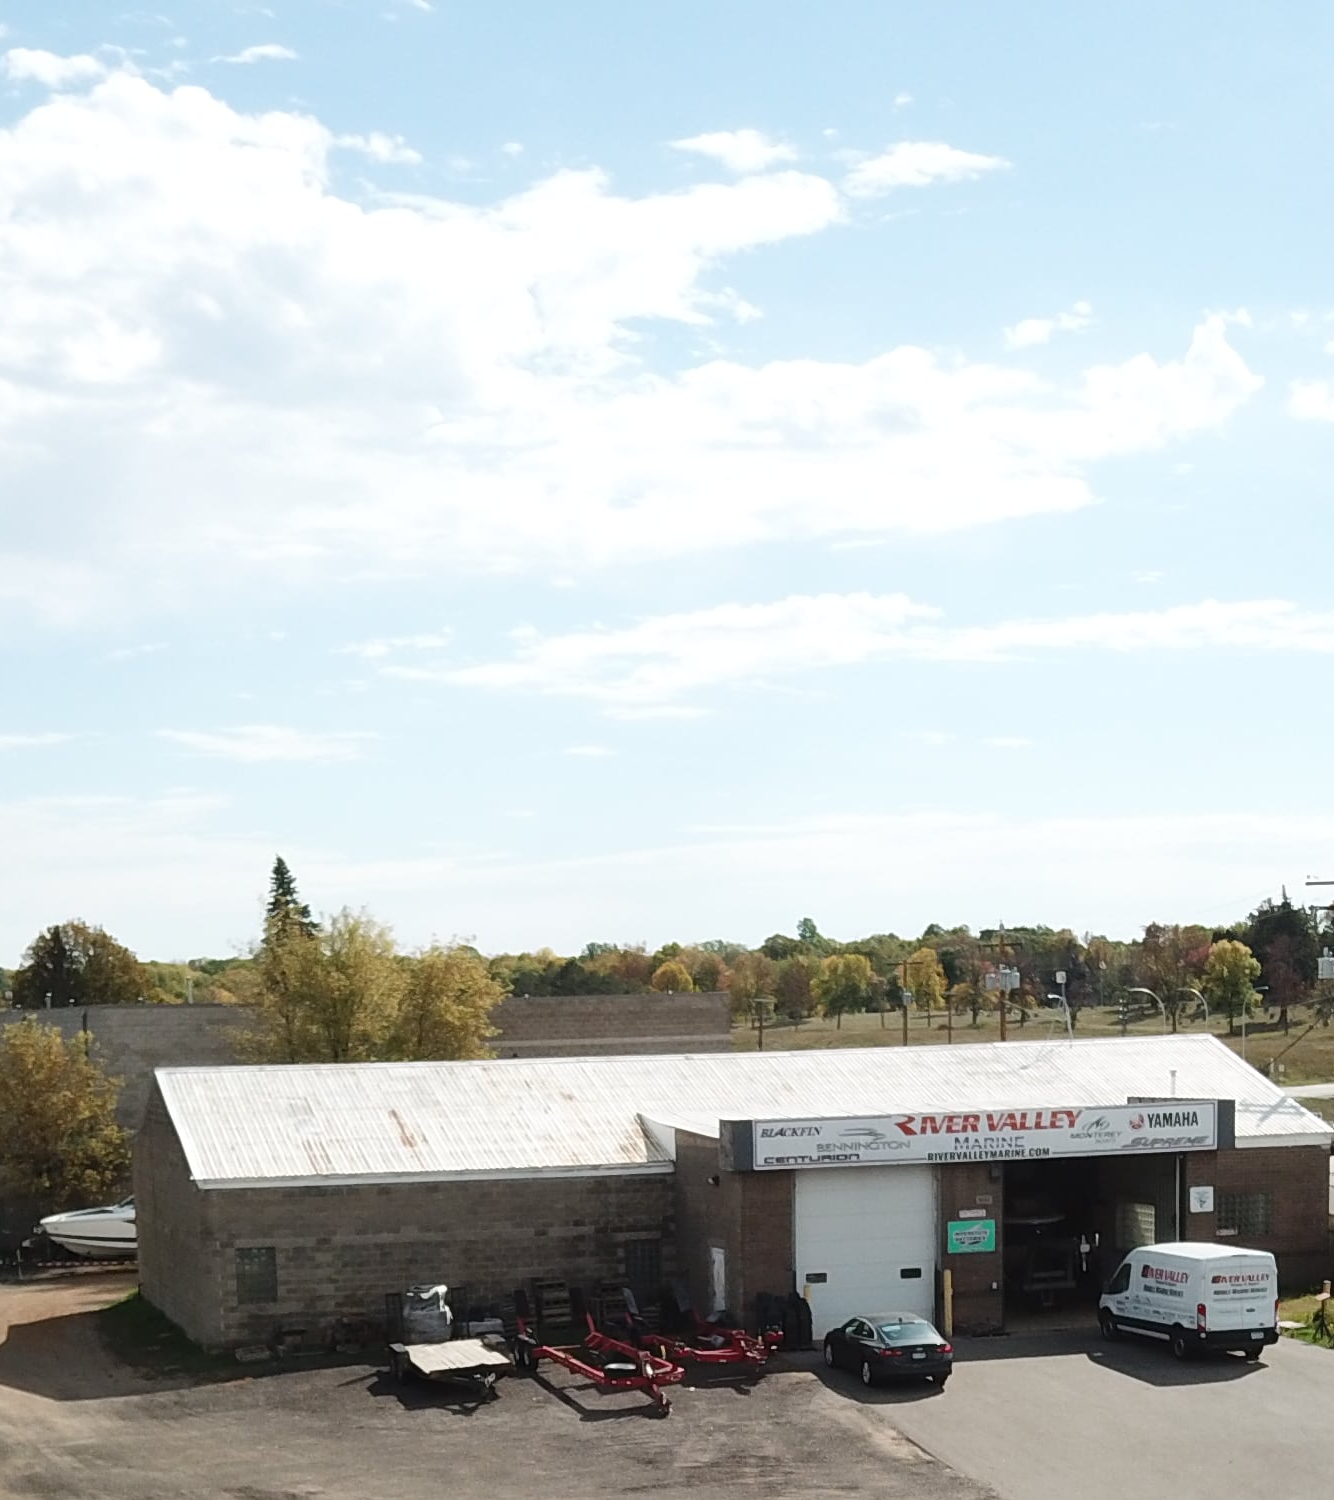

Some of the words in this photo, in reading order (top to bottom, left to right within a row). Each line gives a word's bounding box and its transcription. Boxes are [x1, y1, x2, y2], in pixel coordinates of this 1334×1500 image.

[893, 1113, 981, 1136] RIVER
[986, 1110, 1083, 1132] VALLEY
[1147, 1112, 1199, 1129] YAMAHA
[760, 1126, 823, 1138] BLACKFIN
[1070, 1131, 1123, 1139] MONTEREY
[817, 1140, 910, 1153] BENNINGTON
[954, 1136, 1025, 1151] MARINE
[1124, 1135, 1210, 1148] SUPREME
[764, 1153, 860, 1164] CENTURION
[927, 1147, 1050, 1161] RIVERVALLEYMARINE.COM
